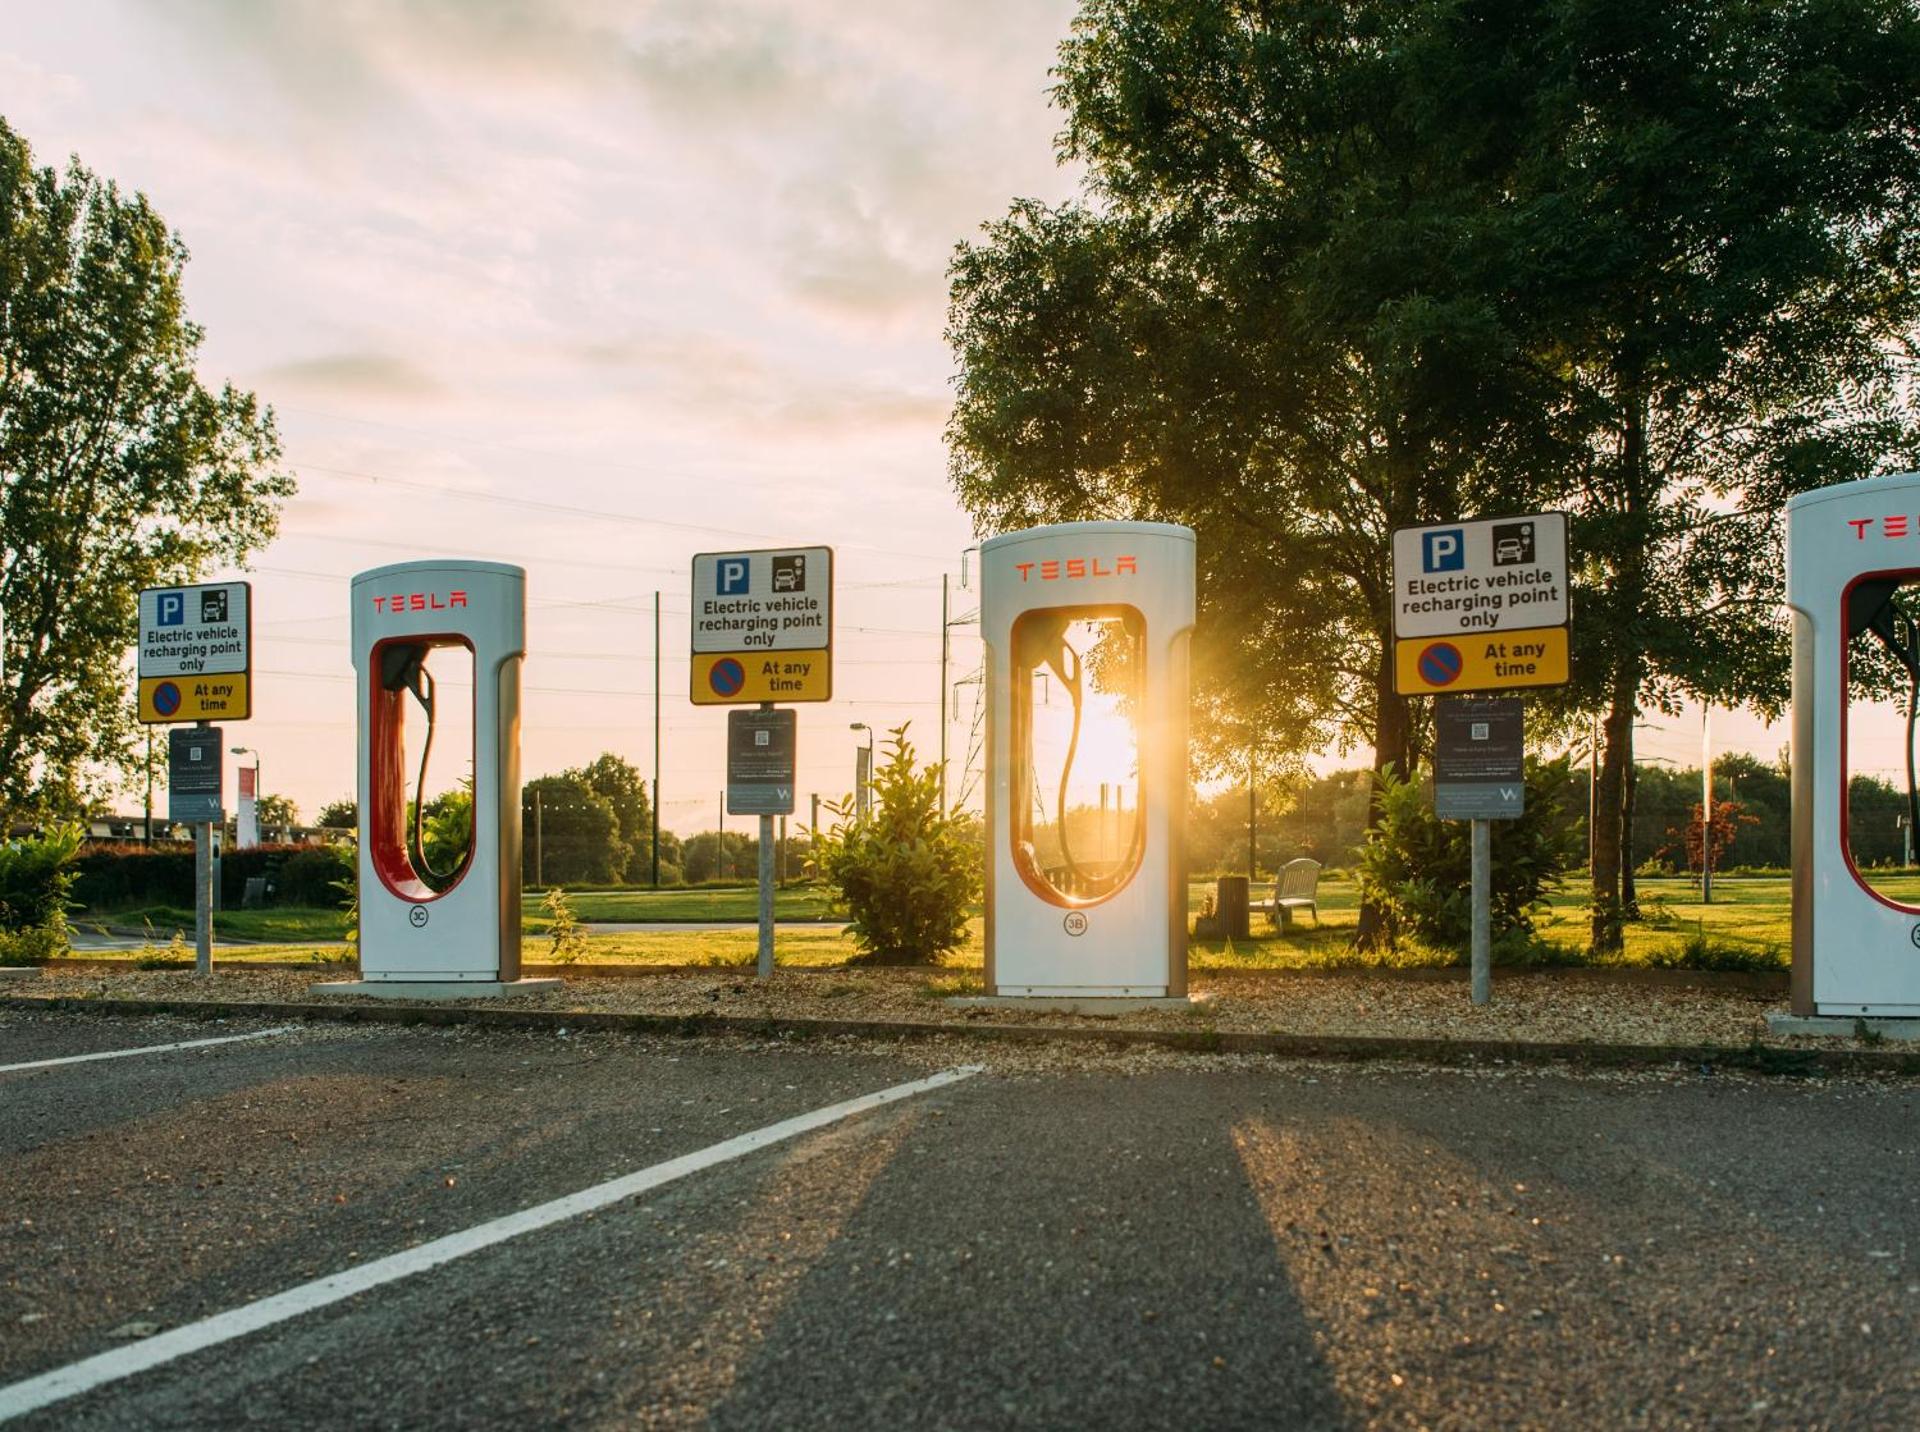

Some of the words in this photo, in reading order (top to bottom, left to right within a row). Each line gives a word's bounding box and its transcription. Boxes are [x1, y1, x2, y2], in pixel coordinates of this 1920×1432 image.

[1847, 515, 1920, 540] TE
[1431, 534, 1457, 569] P
[723, 562, 744, 592] P
[1015, 555, 1136, 583] TESLA
[1408, 575, 1480, 595] Electric
[1485, 569, 1553, 589] vehicle
[373, 589, 468, 615] TESLA
[704, 600, 761, 615] Electric
[765, 597, 818, 612] vehicle
[1402, 593, 1502, 614] recharging
[1509, 586, 1558, 607] point
[163, 596, 179, 623] P
[699, 615, 778, 631] recharging
[783, 613, 822, 629] point
[1460, 611, 1499, 628] only
[147, 629, 193, 643] Electric
[196, 626, 238, 640] vehicle
[744, 632, 775, 647] only
[144, 643, 207, 658] recharging
[210, 641, 241, 655] point
[1484, 643, 1506, 659] At
[1512, 643, 1546, 658] any
[179, 658, 205, 671] only
[762, 661, 780, 675] At
[784, 662, 811, 676] any
[1494, 661, 1536, 677] time
[194, 684, 210, 696] At
[212, 684, 233, 697] any
[770, 678, 803, 691] time
[201, 698, 227, 711] time
[1068, 919, 1083, 929] 3B
